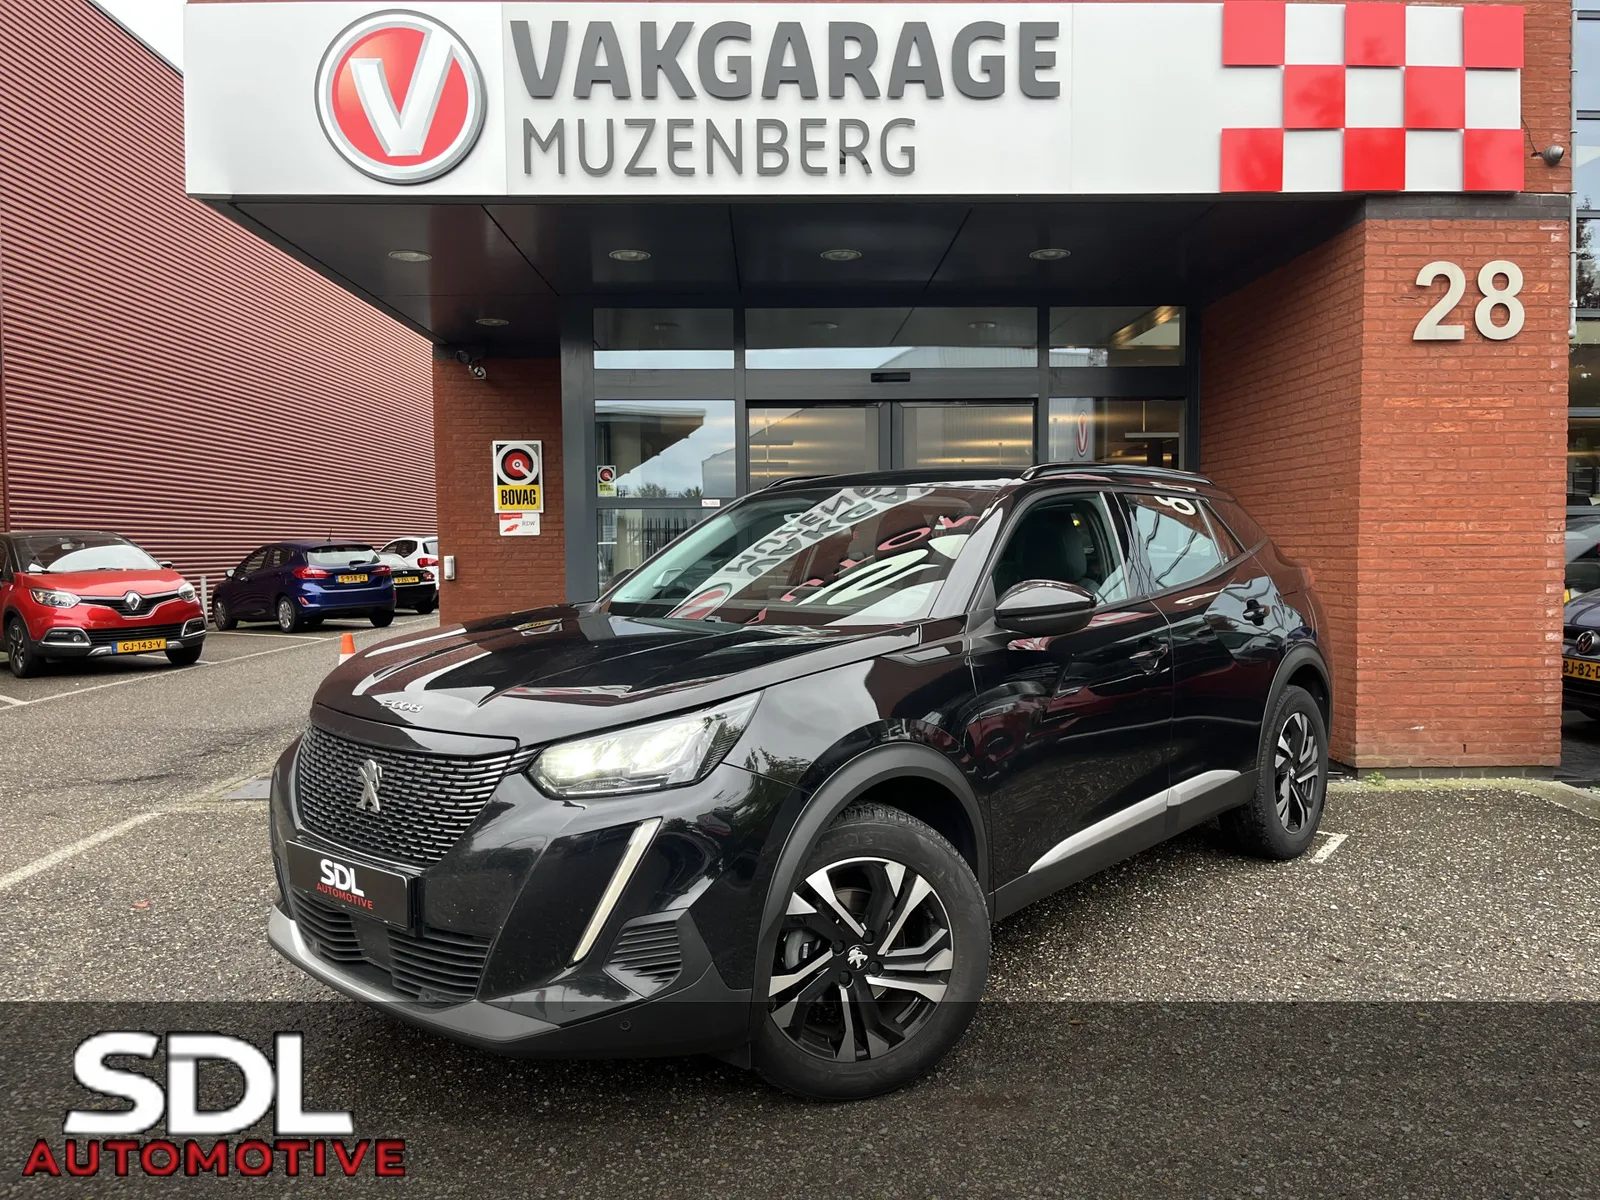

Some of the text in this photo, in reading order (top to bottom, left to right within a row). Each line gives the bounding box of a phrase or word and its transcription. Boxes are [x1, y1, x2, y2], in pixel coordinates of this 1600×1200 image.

[510, 20, 1060, 100] VAKGARAGE
[523, 117, 916, 176] MUZENBERG
[1413, 260, 1525, 341] 28
[501, 489, 536, 506] BOVAG
[123, 640, 162, 651] GJ-143-V
[316, 882, 374, 910] AUTOMOTIVE
[320, 859, 365, 897] SDL
